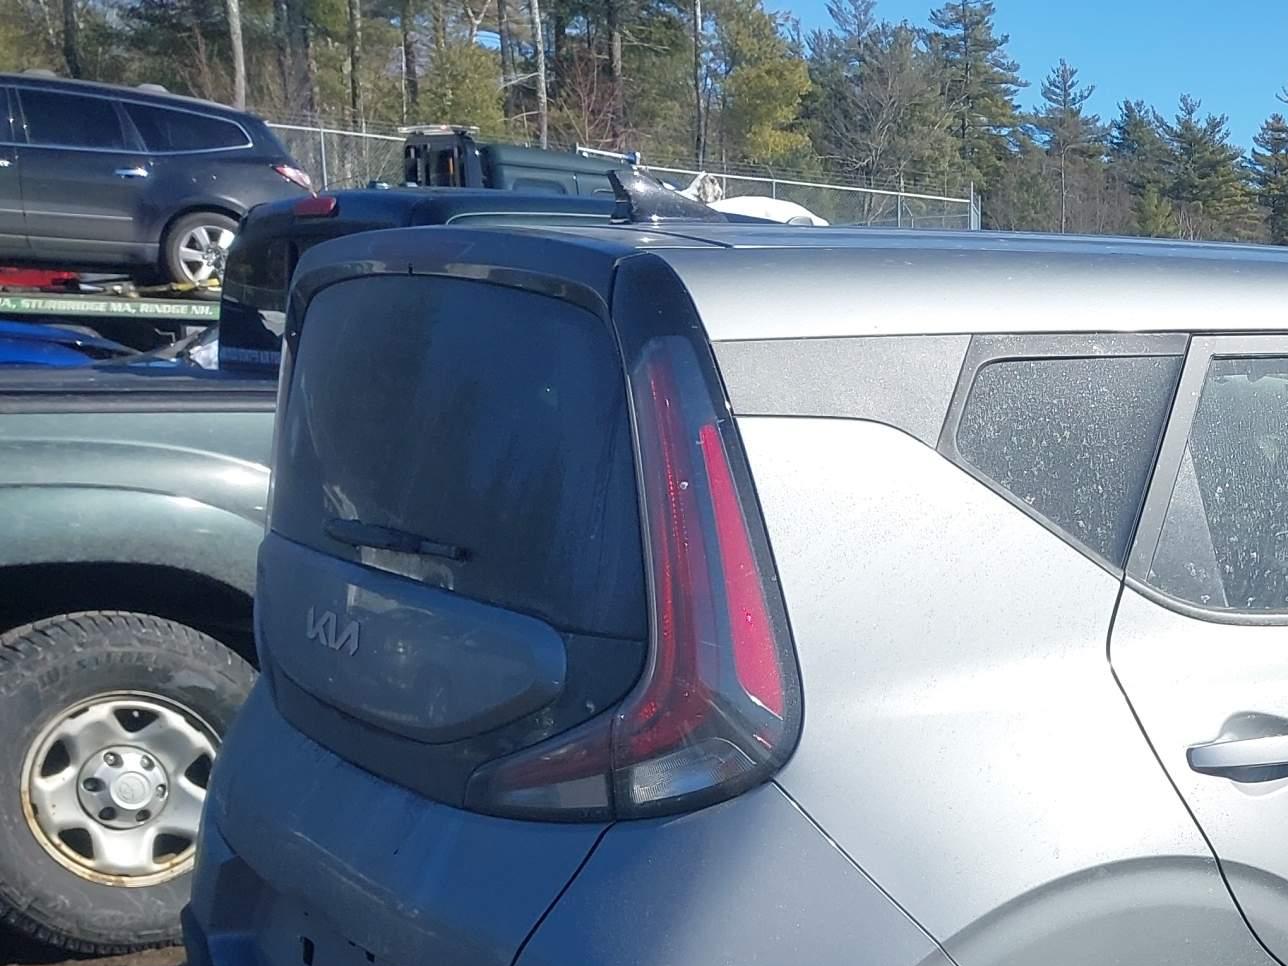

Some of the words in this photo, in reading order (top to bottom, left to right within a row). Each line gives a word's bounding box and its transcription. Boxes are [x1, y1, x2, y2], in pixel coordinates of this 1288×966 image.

[110, 302, 136, 314] MA,
[139, 303, 188, 314] RINDGE
[190, 304, 213, 316] NH.
[305, 604, 360, 657] KIA
